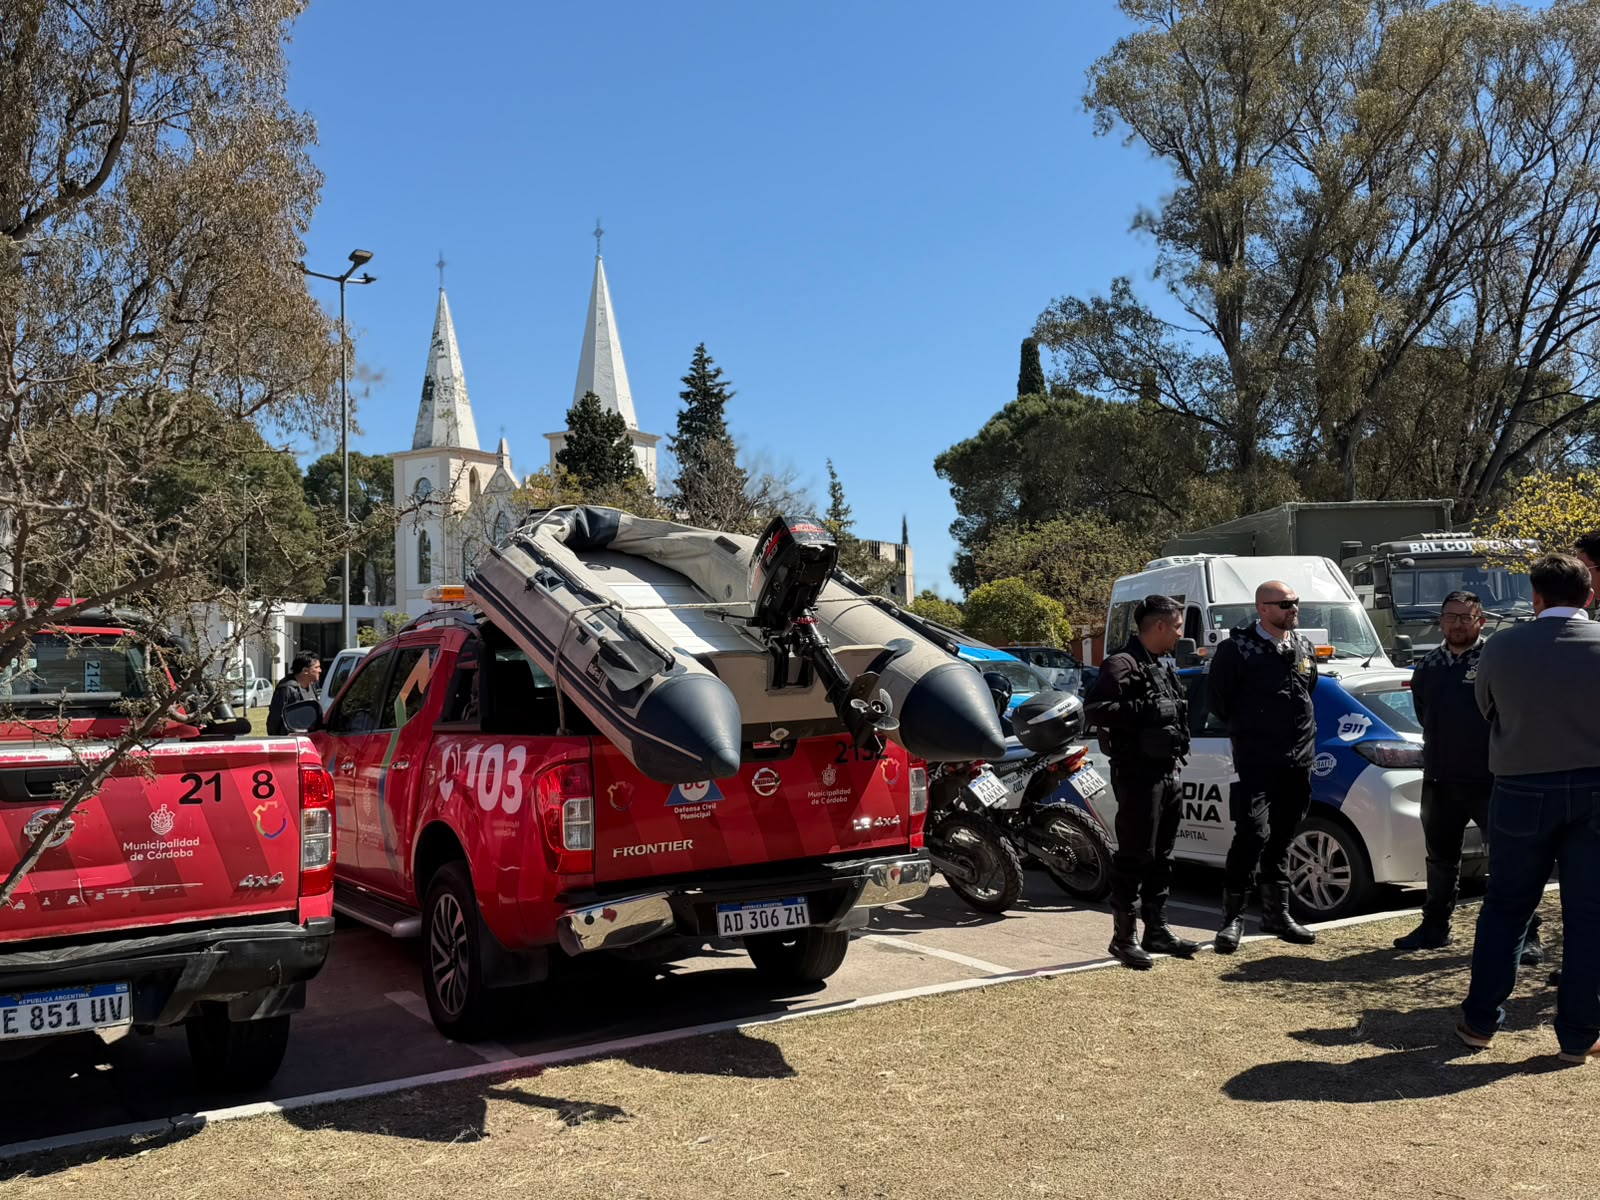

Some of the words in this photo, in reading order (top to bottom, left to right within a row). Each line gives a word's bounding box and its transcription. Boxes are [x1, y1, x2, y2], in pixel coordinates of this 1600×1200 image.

[1408, 541, 1442, 553] BAL
[1341, 723, 1365, 733] 911
[465, 743, 527, 814] 103
[179, 772, 221, 805] 21
[807, 788, 851, 798] Municipalidad
[674, 806, 701, 814] Defensa
[702, 803, 716, 811] Civil
[680, 810, 711, 820] Municipal
[874, 814, 901, 827] 4x4
[123, 837, 200, 851] Municipalidad
[612, 839, 694, 857] FRONTIER
[130, 851, 144, 861] de
[147, 849, 194, 861] Córdoba
[239, 872, 284, 888] 4x4
[724, 912, 744, 933] AD
[748, 909, 780, 930] 306
[784, 906, 806, 926] ZH
[3, 1008, 19, 1034] E
[30, 1001, 80, 1031] 851
[91, 996, 123, 1023] UV
